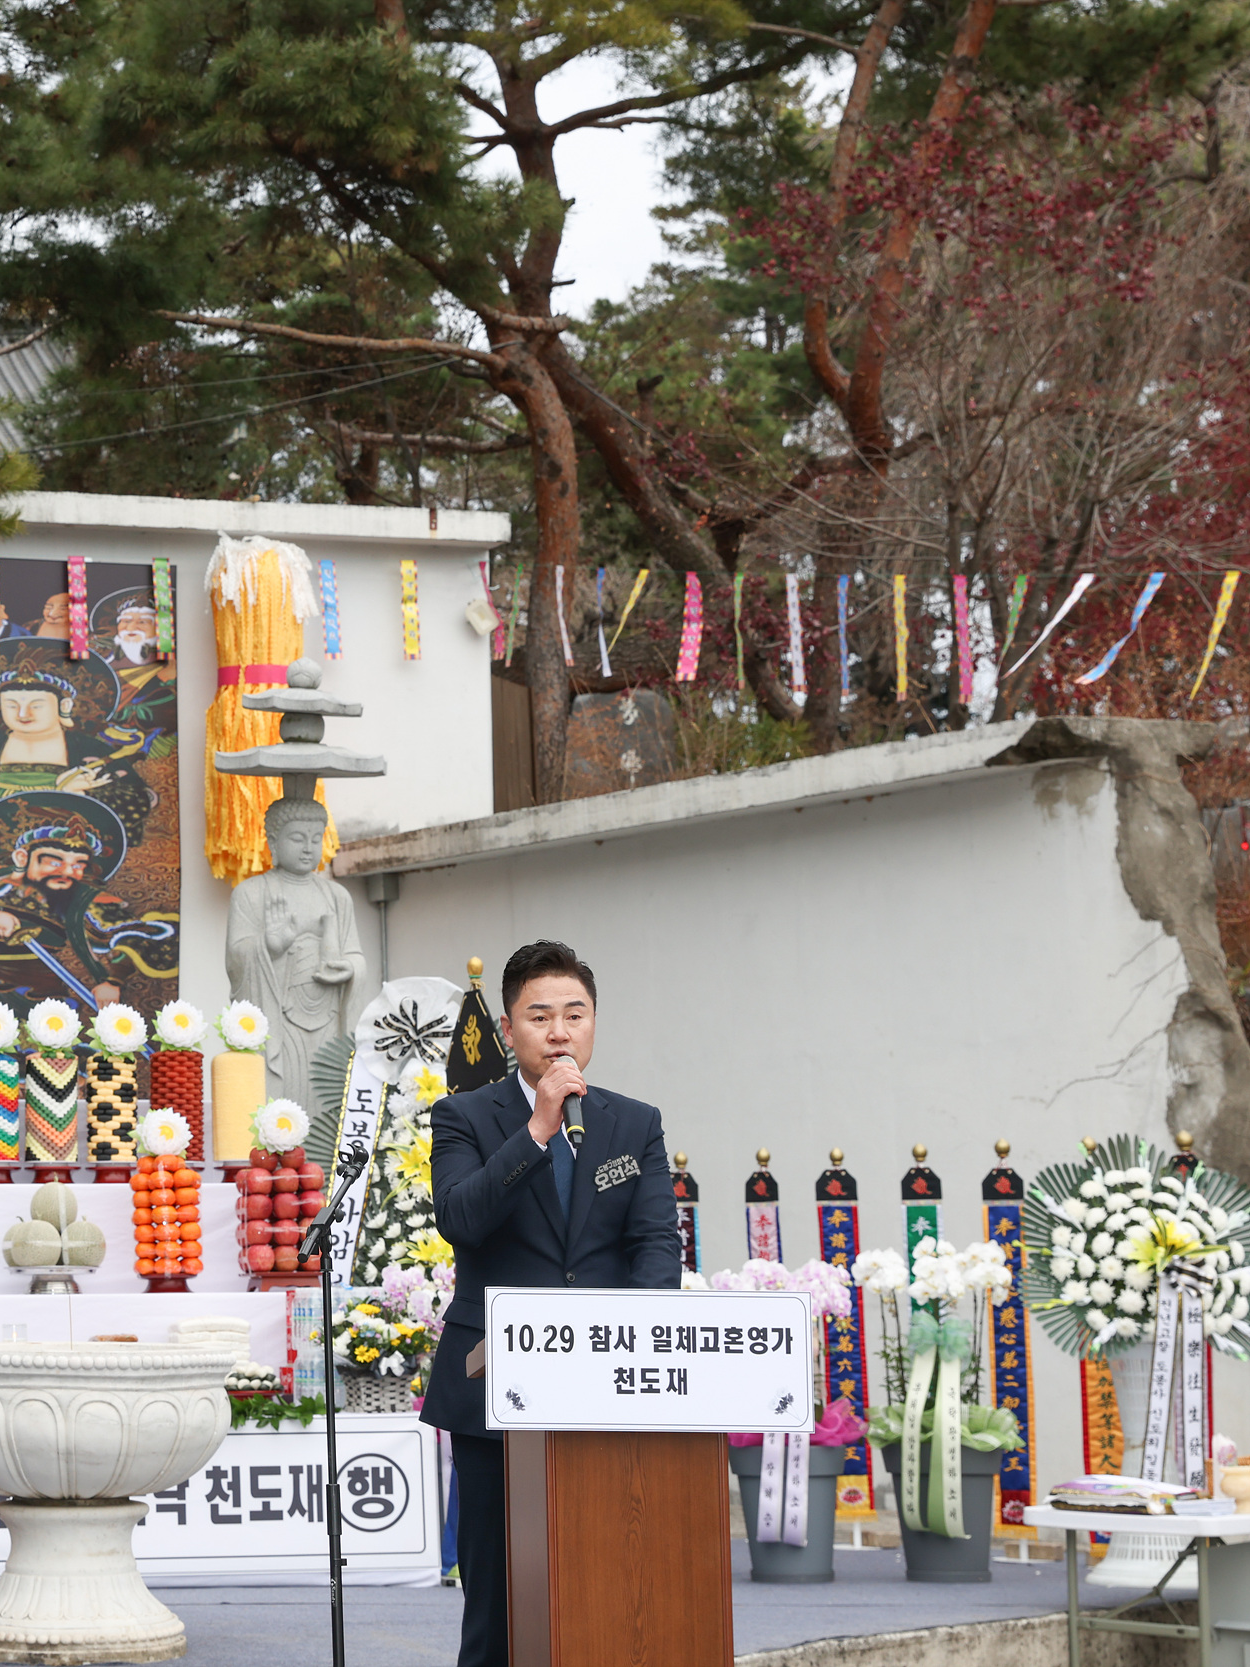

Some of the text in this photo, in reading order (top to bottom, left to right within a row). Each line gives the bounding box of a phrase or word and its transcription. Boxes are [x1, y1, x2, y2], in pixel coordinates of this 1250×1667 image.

[595, 1159, 641, 1192] 오언석
[504, 1324, 794, 1355] 10.29 참사 일체고혼영가
[613, 1367, 688, 1395] 천도재
[205, 1464, 324, 1525] 천도재
[347, 1465, 394, 1518] 행
